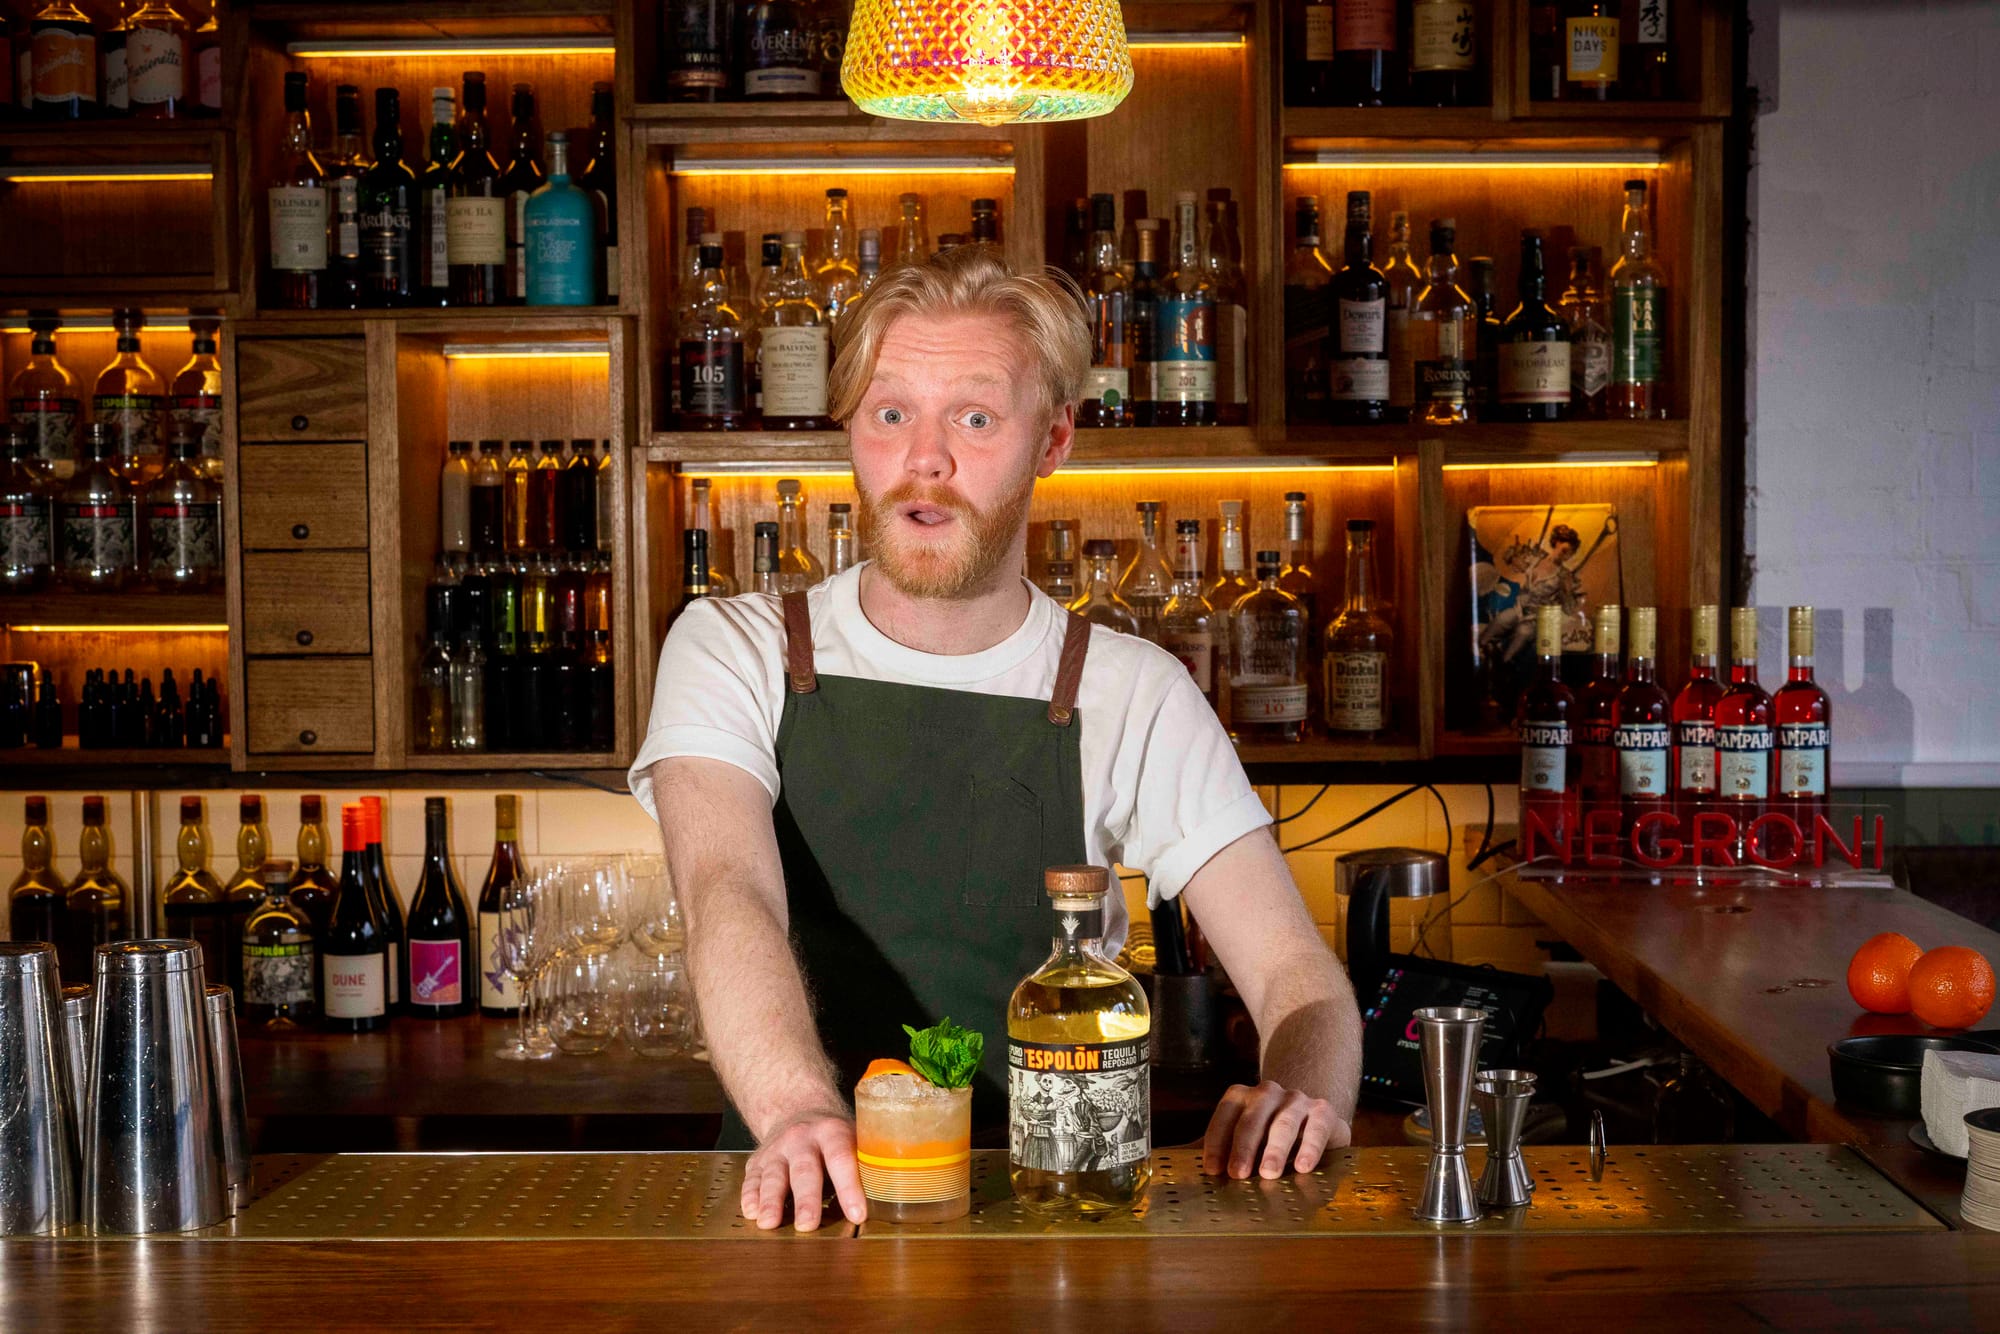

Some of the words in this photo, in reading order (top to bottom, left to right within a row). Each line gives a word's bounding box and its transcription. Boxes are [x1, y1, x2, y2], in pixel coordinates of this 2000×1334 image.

[1574, 25, 1617, 37] NIKKA
[1574, 41, 1607, 52] DAYS
[272, 199, 320, 207] TALISKER
[693, 365, 725, 384] 105
[1179, 377, 1197, 387] 2012
[1536, 377, 1548, 388] 12
[1264, 703, 1284, 714] 10
[1614, 730, 1671, 748] CAMPARI
[1716, 731, 1774, 749] CAMPARI
[1525, 809, 1884, 869] NEGRONI
[332, 974, 366, 986] DUNE
[1102, 1045, 1137, 1060] TEQUILA
[1103, 1056, 1137, 1069] REPOSADO
